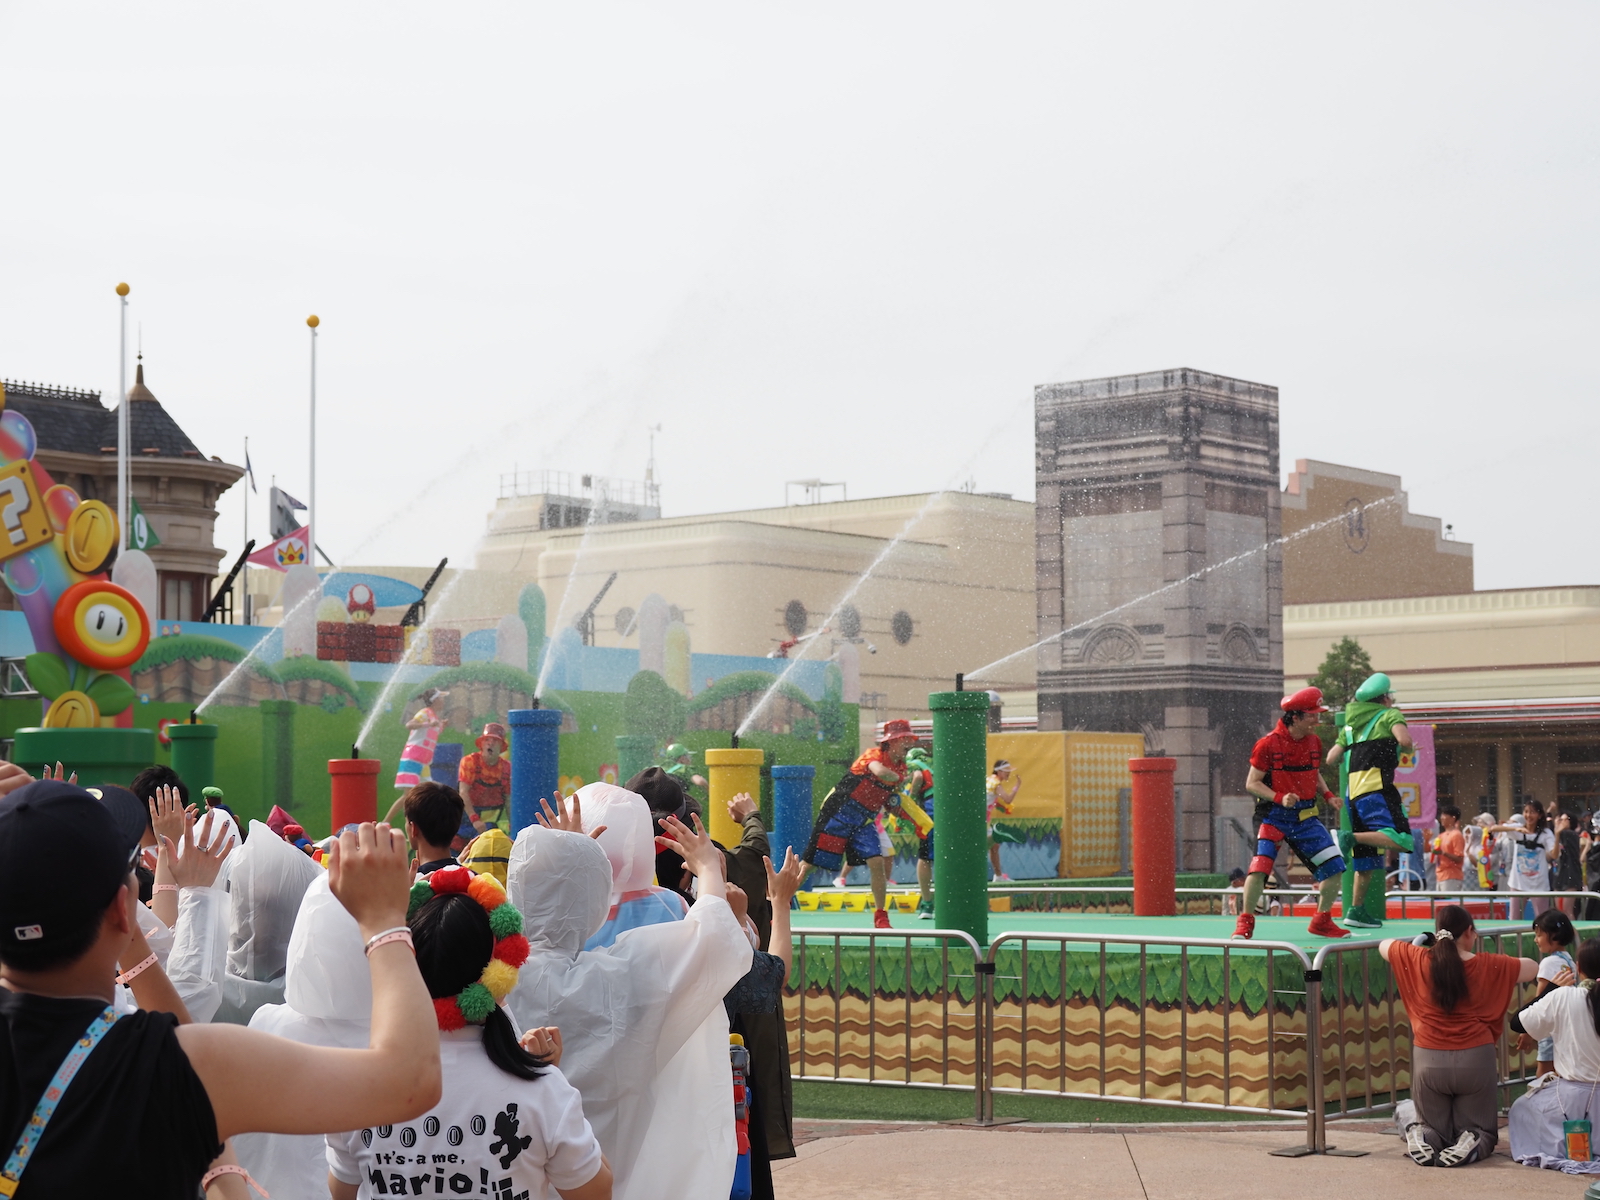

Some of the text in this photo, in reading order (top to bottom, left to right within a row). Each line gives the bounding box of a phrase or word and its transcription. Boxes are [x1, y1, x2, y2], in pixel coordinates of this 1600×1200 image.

[0, 476, 30, 545] ?
[1398, 788, 1416, 812] ?
[431, 1153, 465, 1164] me,
